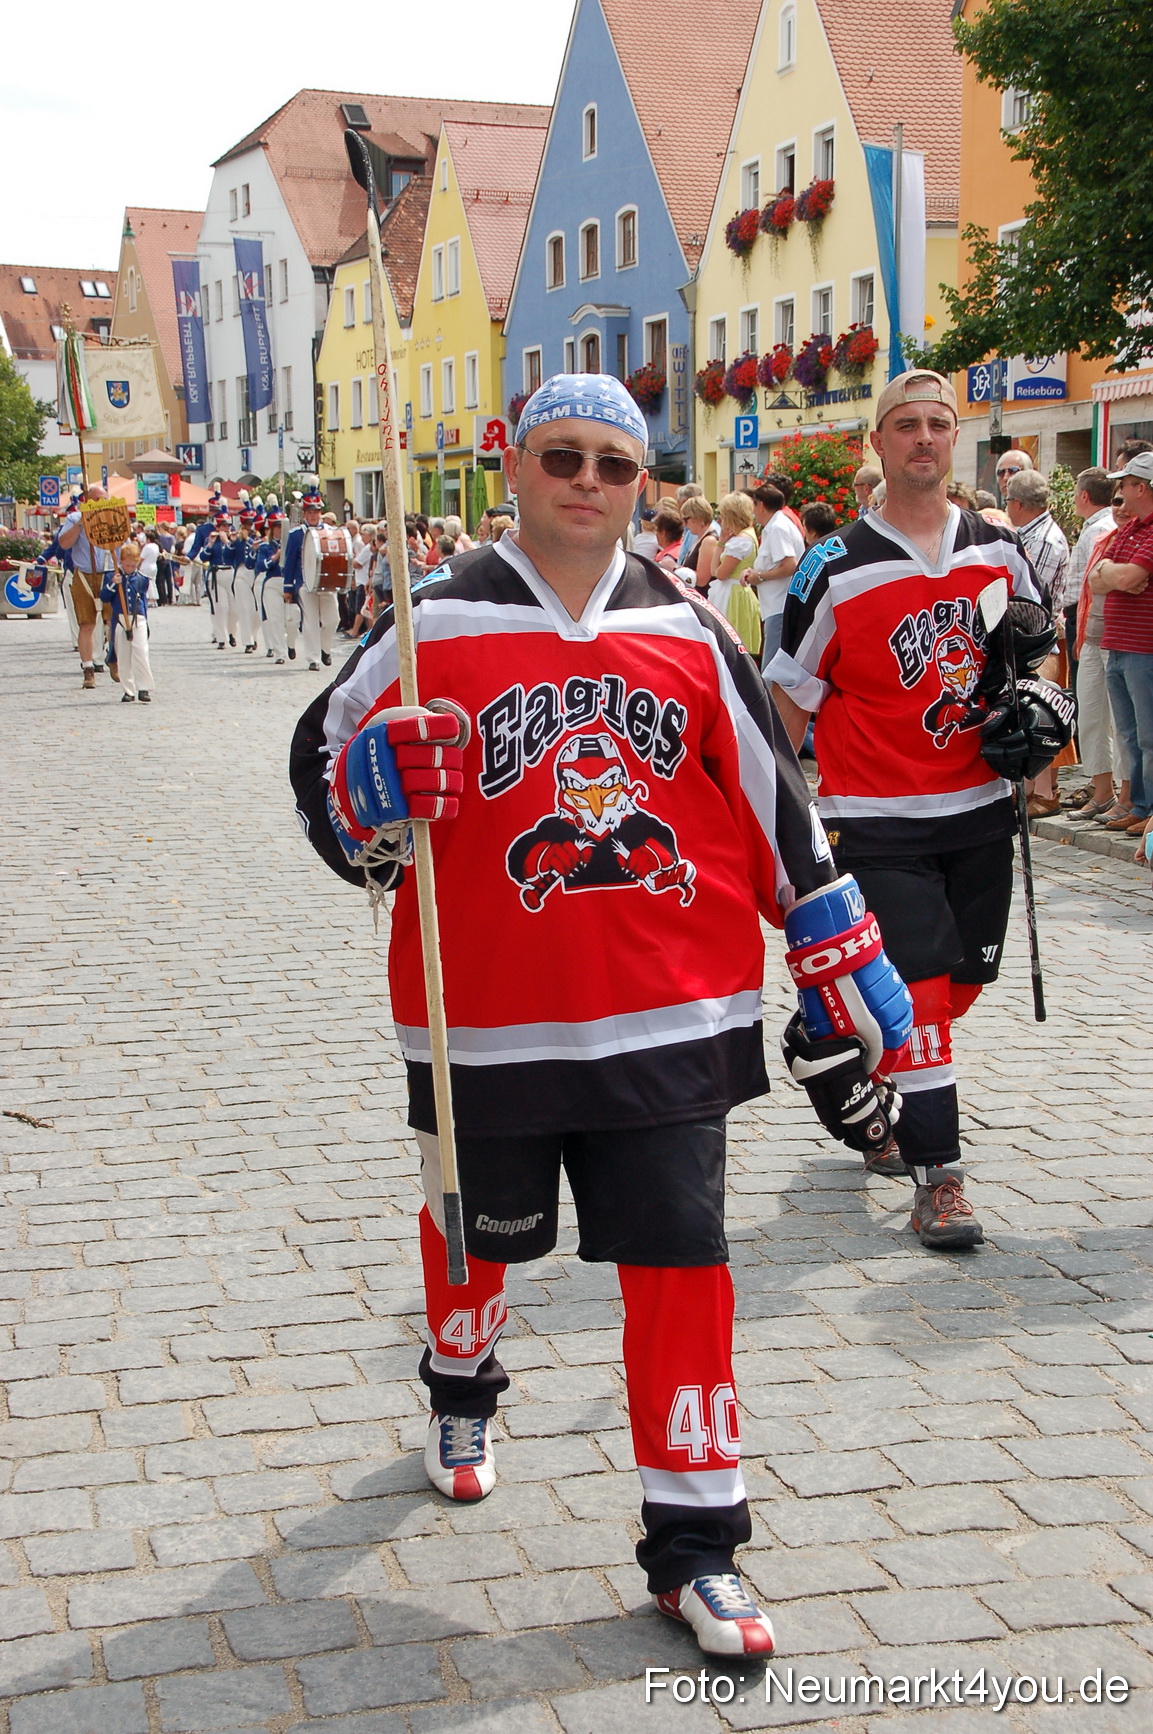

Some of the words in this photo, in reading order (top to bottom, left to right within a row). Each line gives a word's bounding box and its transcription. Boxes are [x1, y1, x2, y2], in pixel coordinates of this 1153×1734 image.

[252, 307, 269, 364] RUPPERT
[356, 349, 375, 370] HOTE
[972, 373, 991, 391] DER
[1016, 386, 1063, 396] Reisebüro
[523, 404, 571, 430] TEAM
[740, 419, 754, 446] P
[42, 497, 59, 505] TAXI
[477, 674, 688, 800] Eagles
[368, 737, 389, 809] KOHO
[822, 985, 836, 1008] HG
[833, 1010, 846, 1030] 15
[908, 1022, 945, 1066] 11
[475, 1213, 545, 1236] Cooper
[440, 1289, 506, 1355] 40
[666, 1381, 742, 1465] 40
